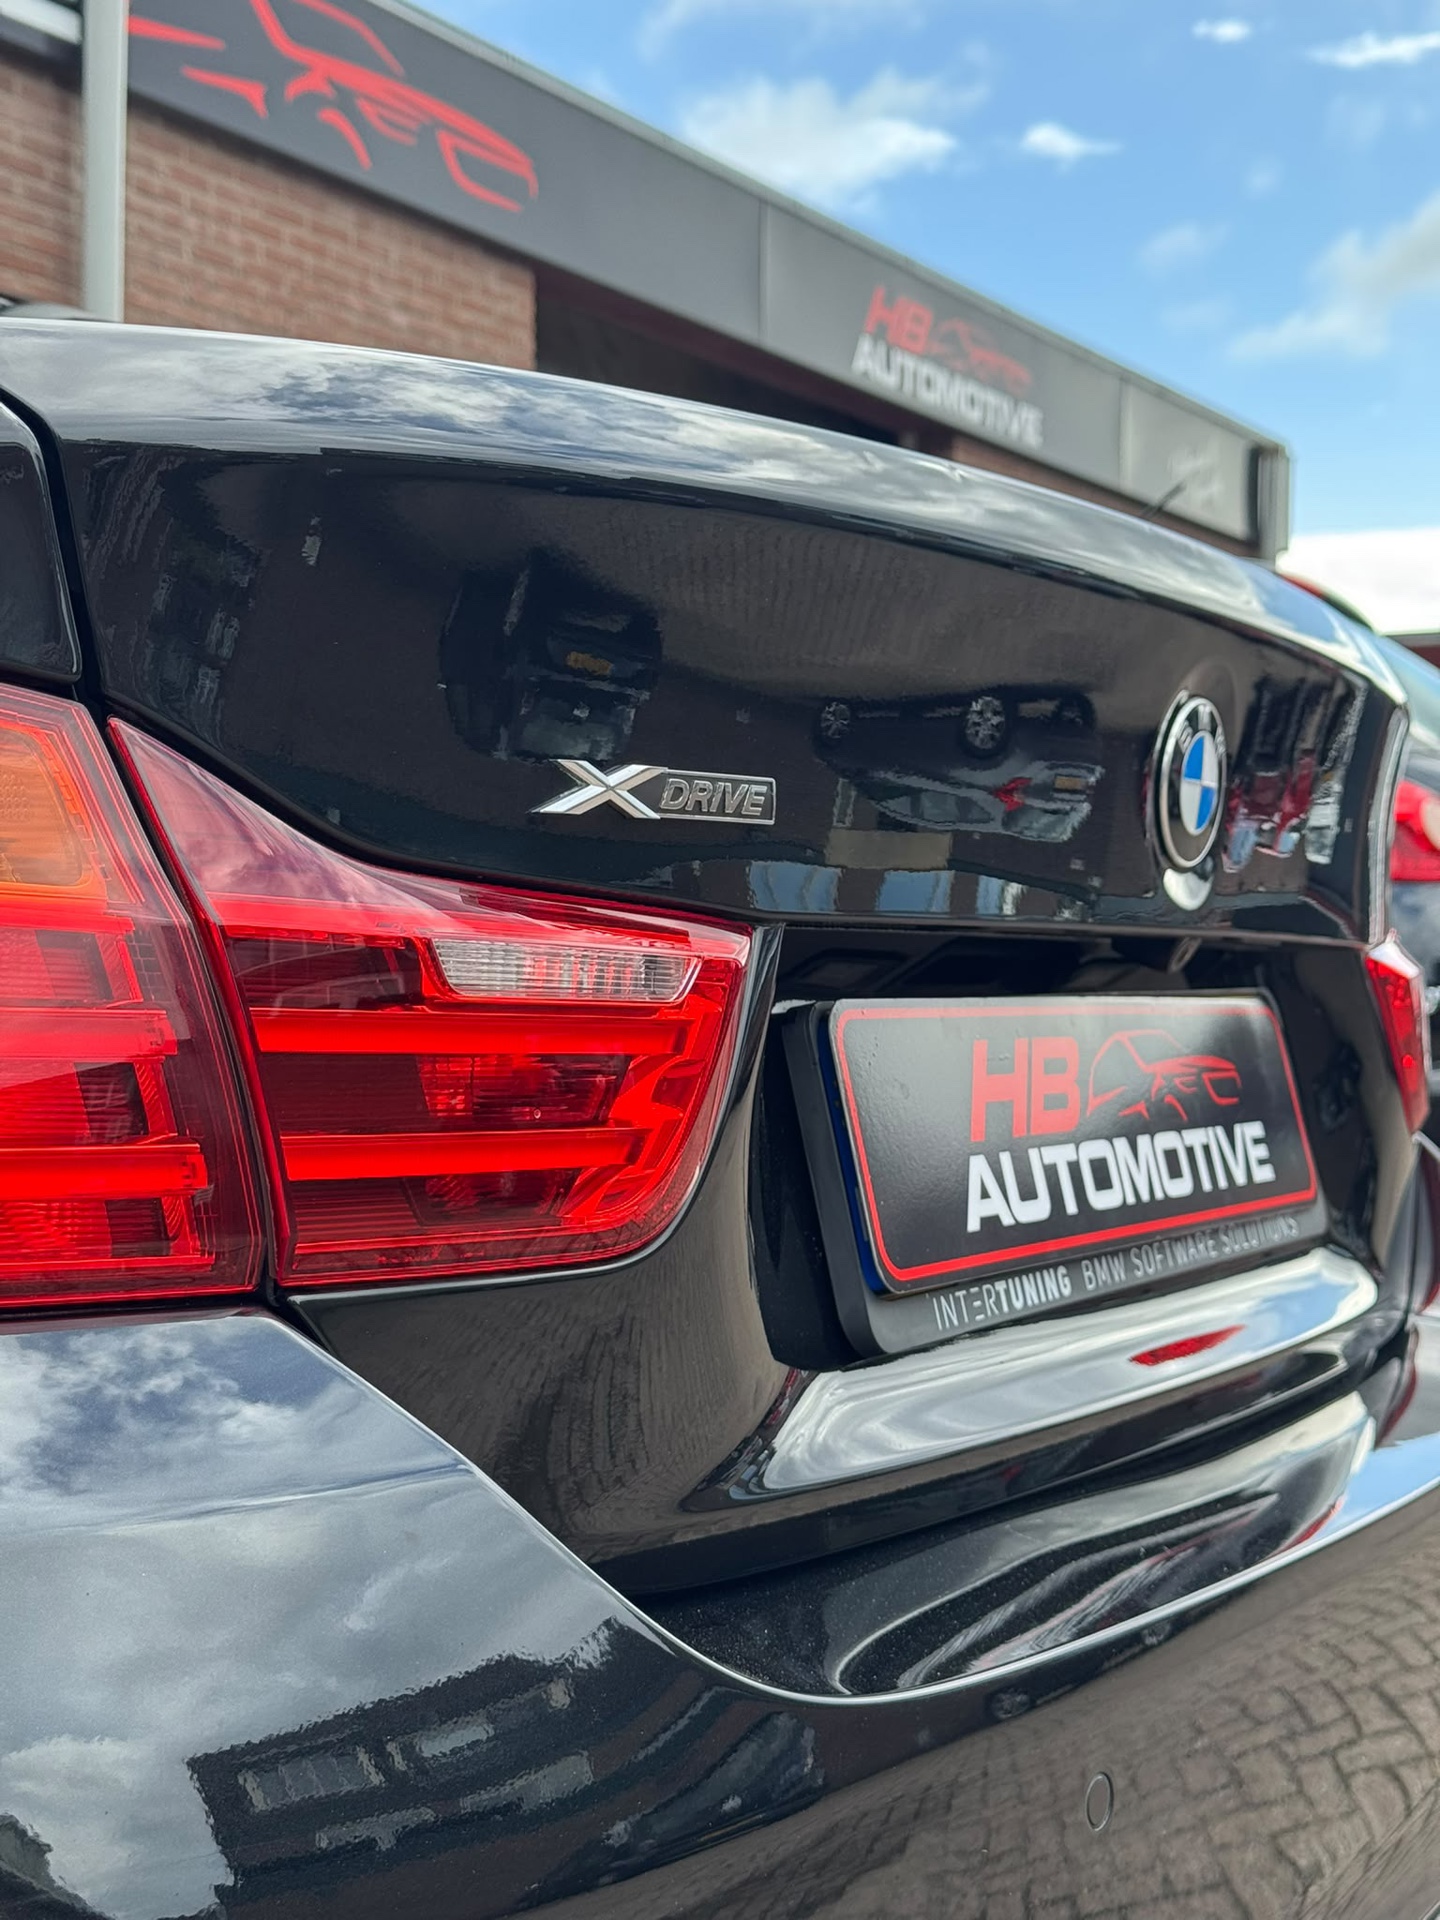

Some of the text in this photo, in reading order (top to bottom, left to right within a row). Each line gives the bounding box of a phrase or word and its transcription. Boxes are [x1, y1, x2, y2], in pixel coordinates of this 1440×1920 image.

[864, 286, 933, 355] HB
[851, 332, 1043, 449] AUTOMOTIVE
[970, 1036, 1080, 1142] HB
[966, 1120, 1276, 1233] AUTOMOTIVE
[933, 1214, 1299, 1331] INTERTUNING BMW SOFTWARE SOLUTIONS
